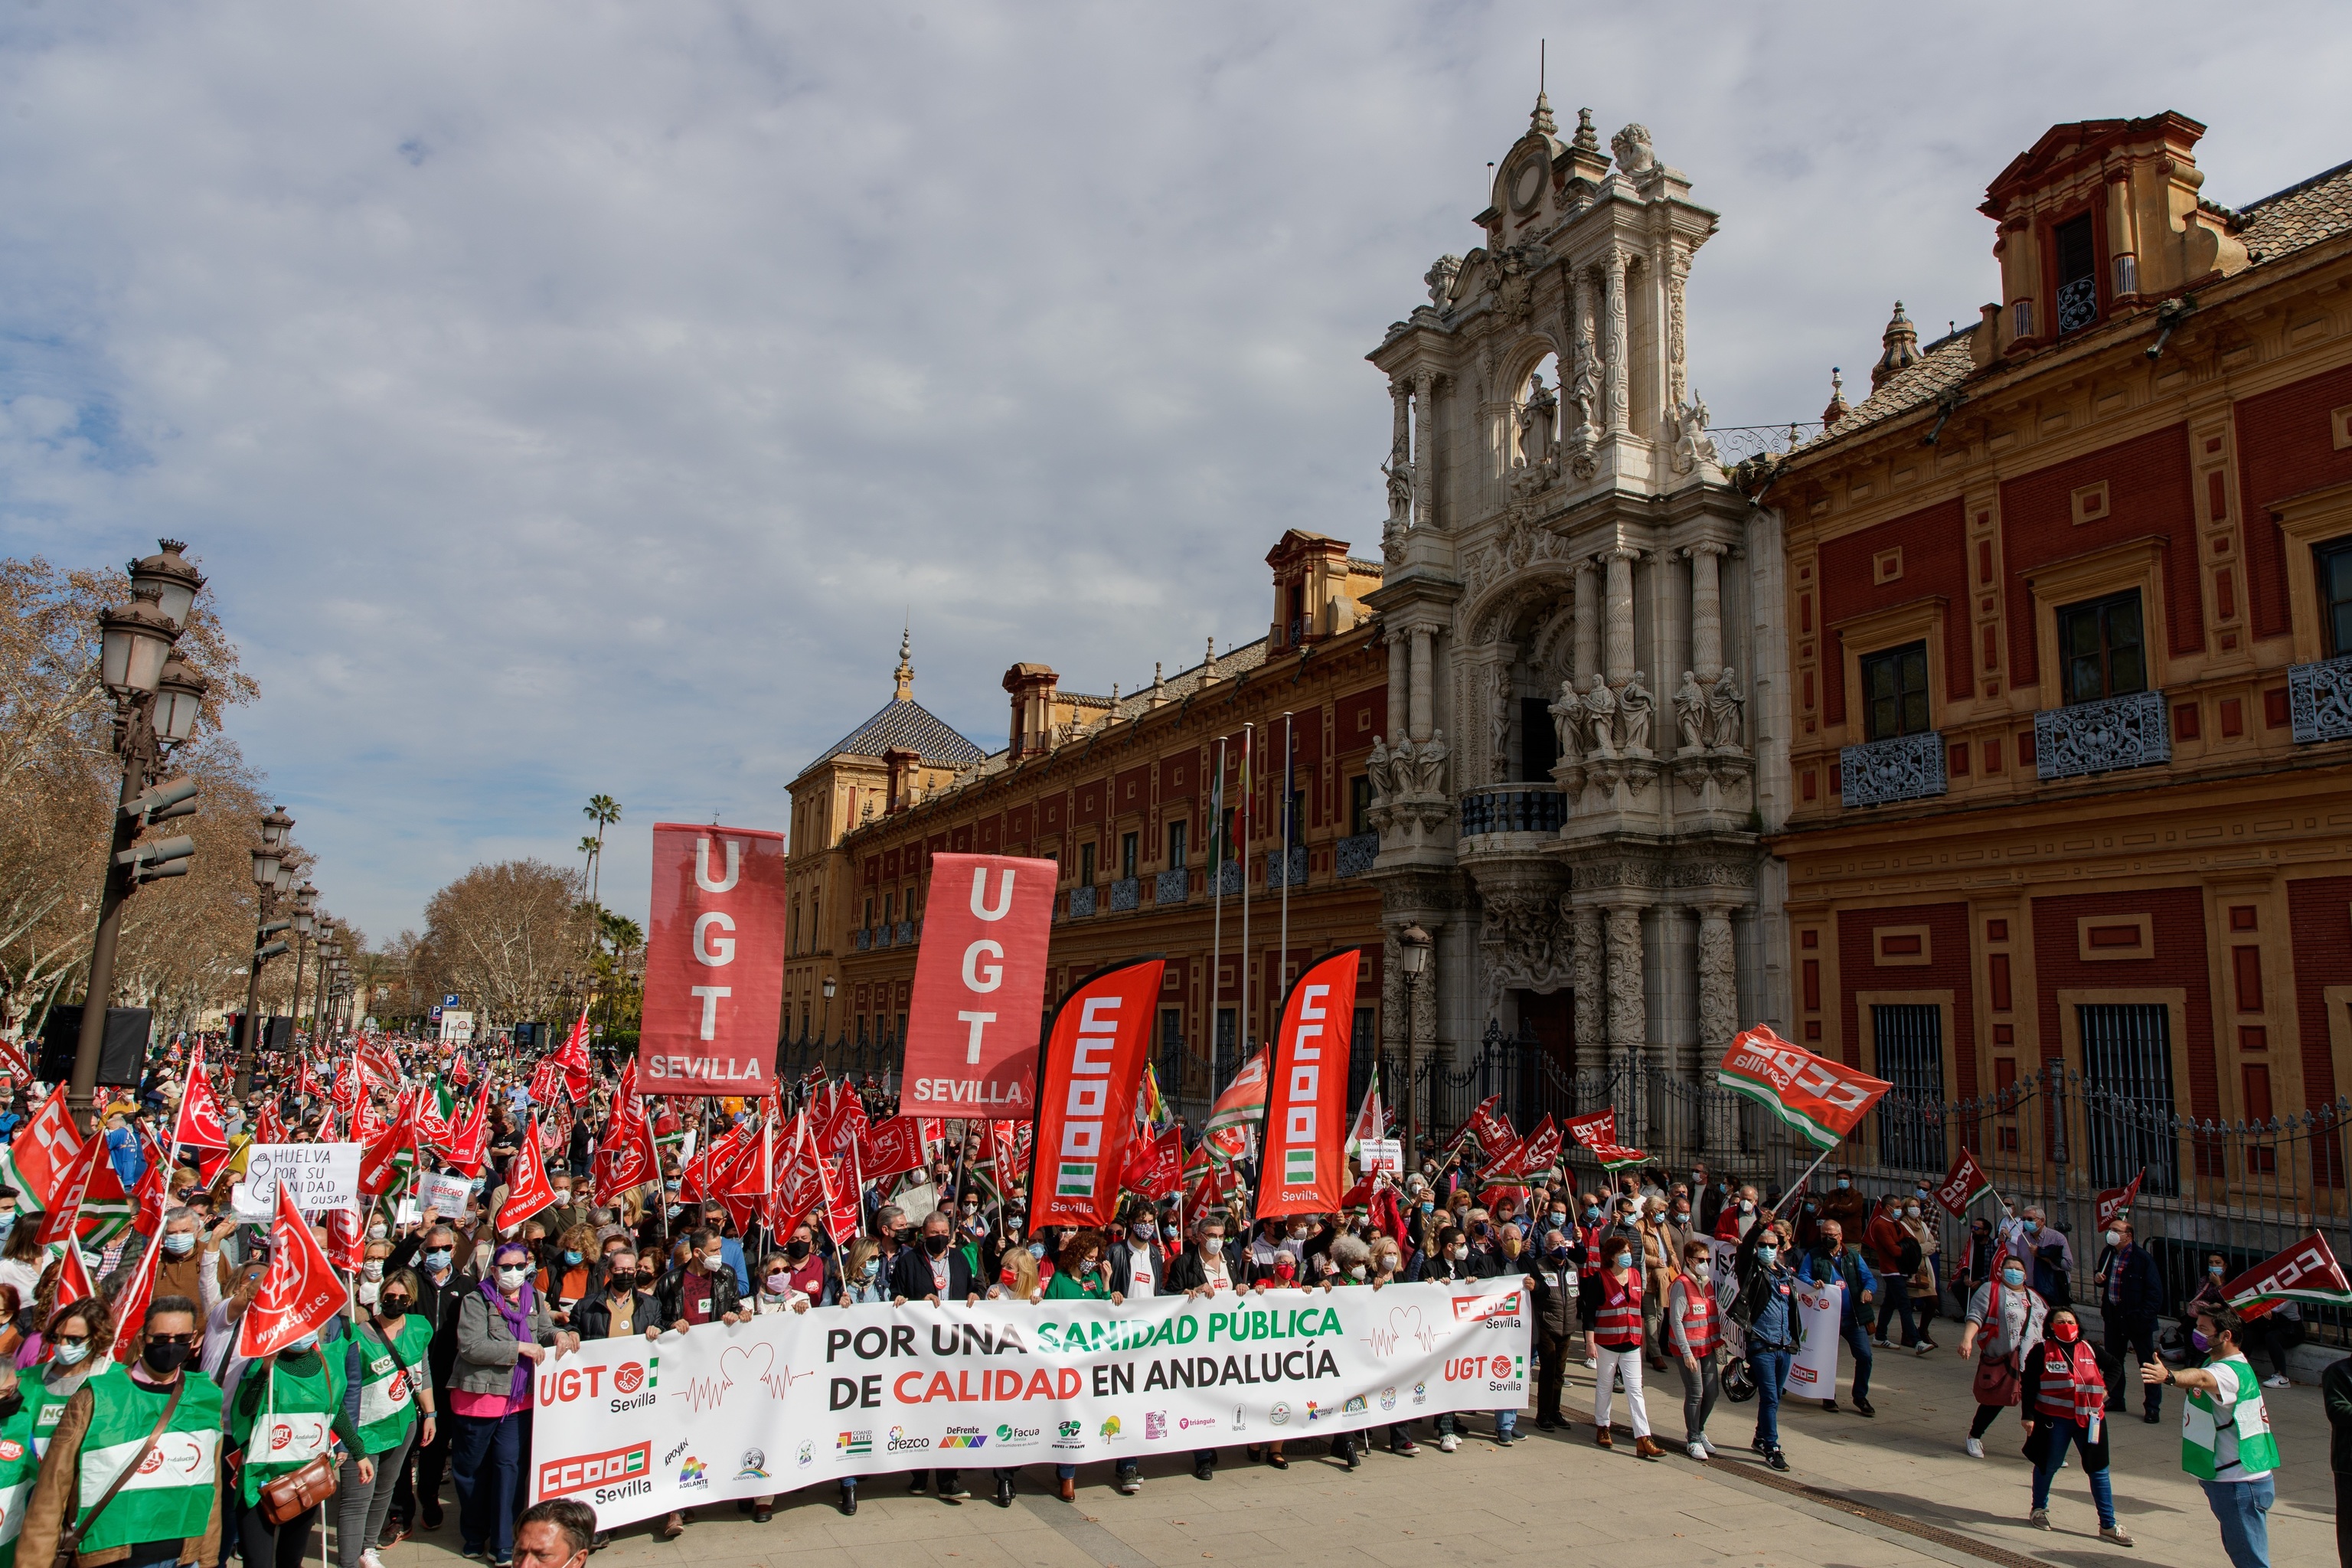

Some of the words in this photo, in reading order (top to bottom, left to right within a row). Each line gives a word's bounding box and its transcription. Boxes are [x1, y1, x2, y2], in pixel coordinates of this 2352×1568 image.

[691, 838, 740, 1040] UGT
[958, 868, 1015, 1064] UGT
[446, 995, 454, 1004] P
[433, 1006, 440, 1014] P
[649, 1055, 762, 1080] SEVILLA
[1285, 985, 1331, 1143] CCOO
[1060, 997, 1122, 1158] CCOO
[914, 1078, 1022, 1104] SEVILLA
[832, 1109, 858, 1149] UGT
[274, 1149, 332, 1164] HUELVA
[273, 1167, 297, 1180] POR
[306, 1167, 325, 1179] SU
[782, 1156, 818, 1203] UGT
[266, 1181, 336, 1194] SNIDAD
[431, 1185, 464, 1197] DERECHO
[1282, 1190, 1319, 1203] Sevilla
[312, 1195, 348, 1205] OUSAP
[1050, 1201, 1094, 1214] Sevilla
[827, 1325, 919, 1363] POR
[931, 1323, 1028, 1356] UNA
[1037, 1314, 1199, 1354] SANIDAD
[1208, 1302, 1344, 1343] PÚBLICA
[1486, 1317, 1521, 1329] Sevilla
[829, 1374, 883, 1412] DE
[893, 1368, 1083, 1405] CALIDAD
[1092, 1362, 1135, 1397] EN
[1143, 1340, 1341, 1393] ANDALUCÍA
[1445, 1356, 1488, 1382] UGT
[540, 1365, 607, 1407] UGT
[1489, 1381, 1521, 1391] Sevilla
[610, 1393, 656, 1413] Sevilla
[1190, 1417, 1216, 1426] triángulo
[1014, 1427, 1040, 1437] facua
[665, 1437, 689, 1467] APOYAN
[887, 1438, 929, 1451] crezco
[543, 1454, 626, 1493] CCOO
[679, 1478, 709, 1489] ADELANTE
[596, 1478, 652, 1505] Sevilla
